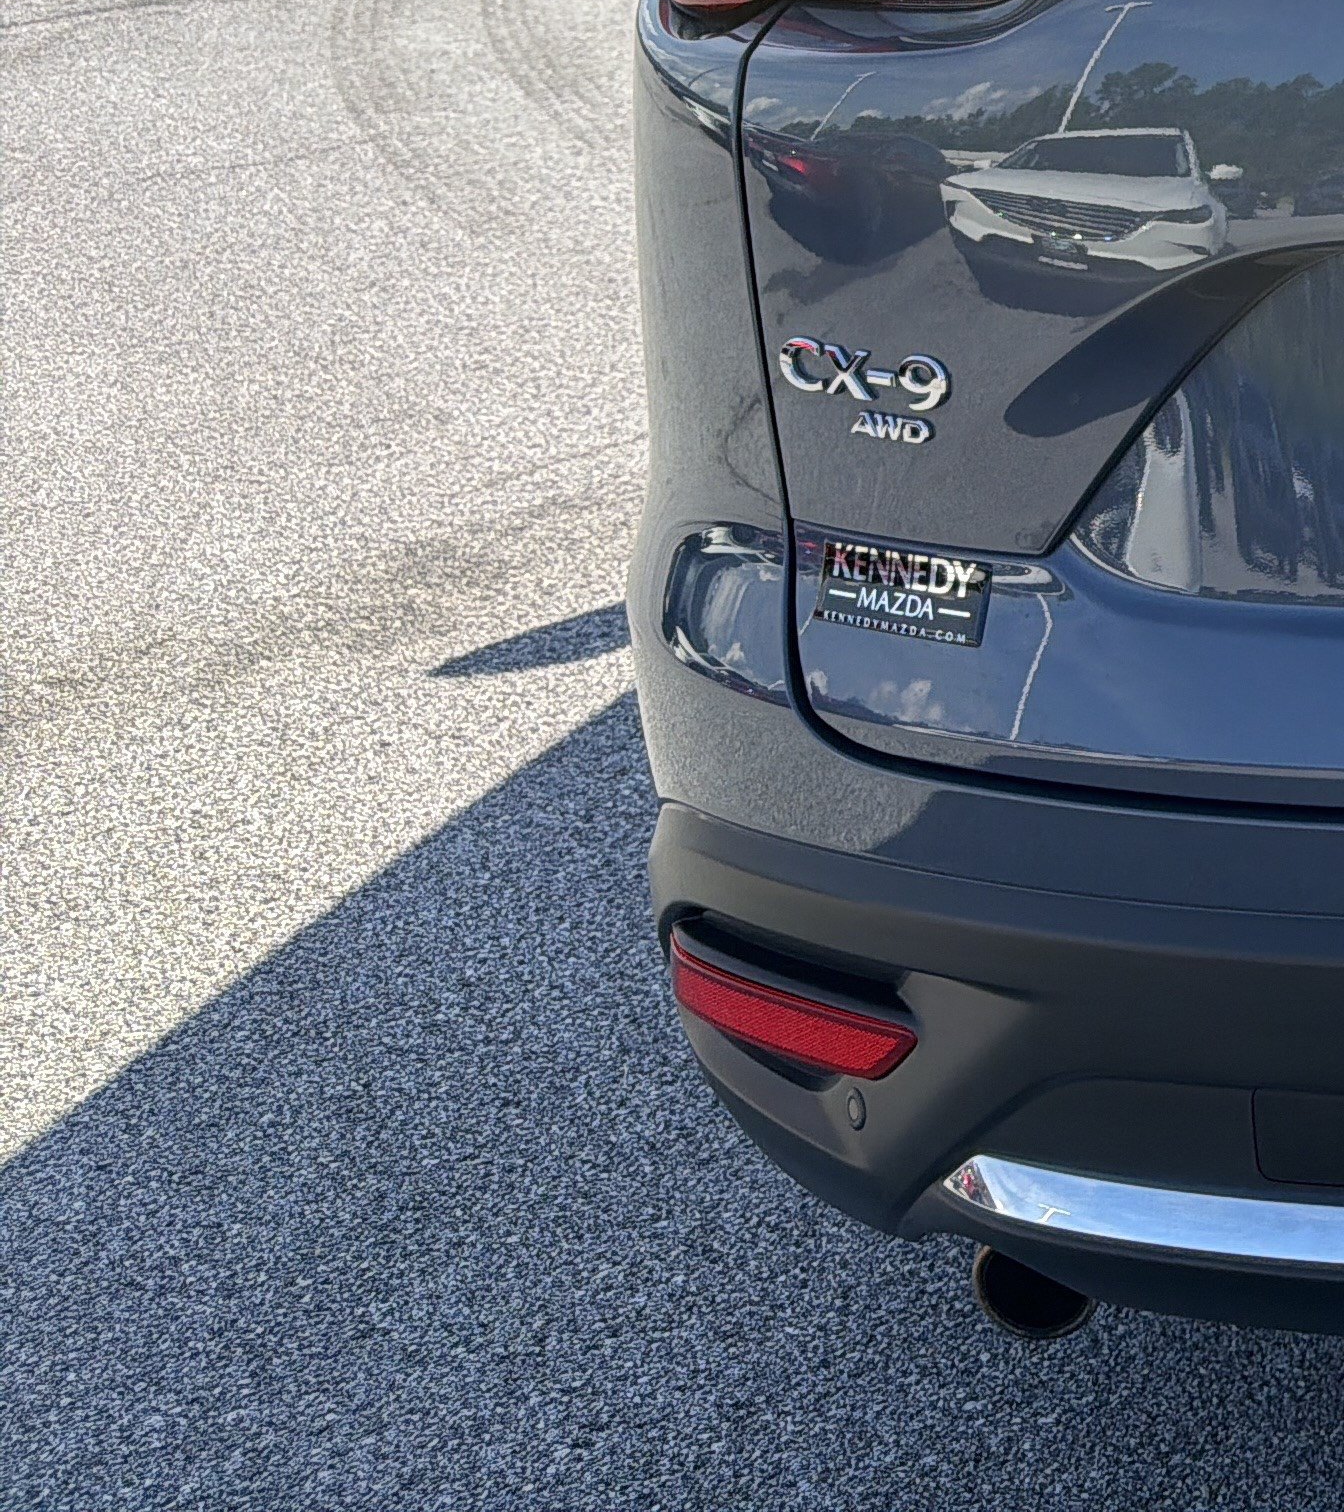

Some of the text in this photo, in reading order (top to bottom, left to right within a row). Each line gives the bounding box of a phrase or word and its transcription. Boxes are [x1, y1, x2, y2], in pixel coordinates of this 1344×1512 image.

[779, 336, 950, 412] CX-9
[850, 410, 936, 445] AWD
[832, 542, 979, 599] KENNEDY
[856, 587, 935, 621] MAZDA
[822, 609, 968, 645] KENNEDYMAZDA.COM
